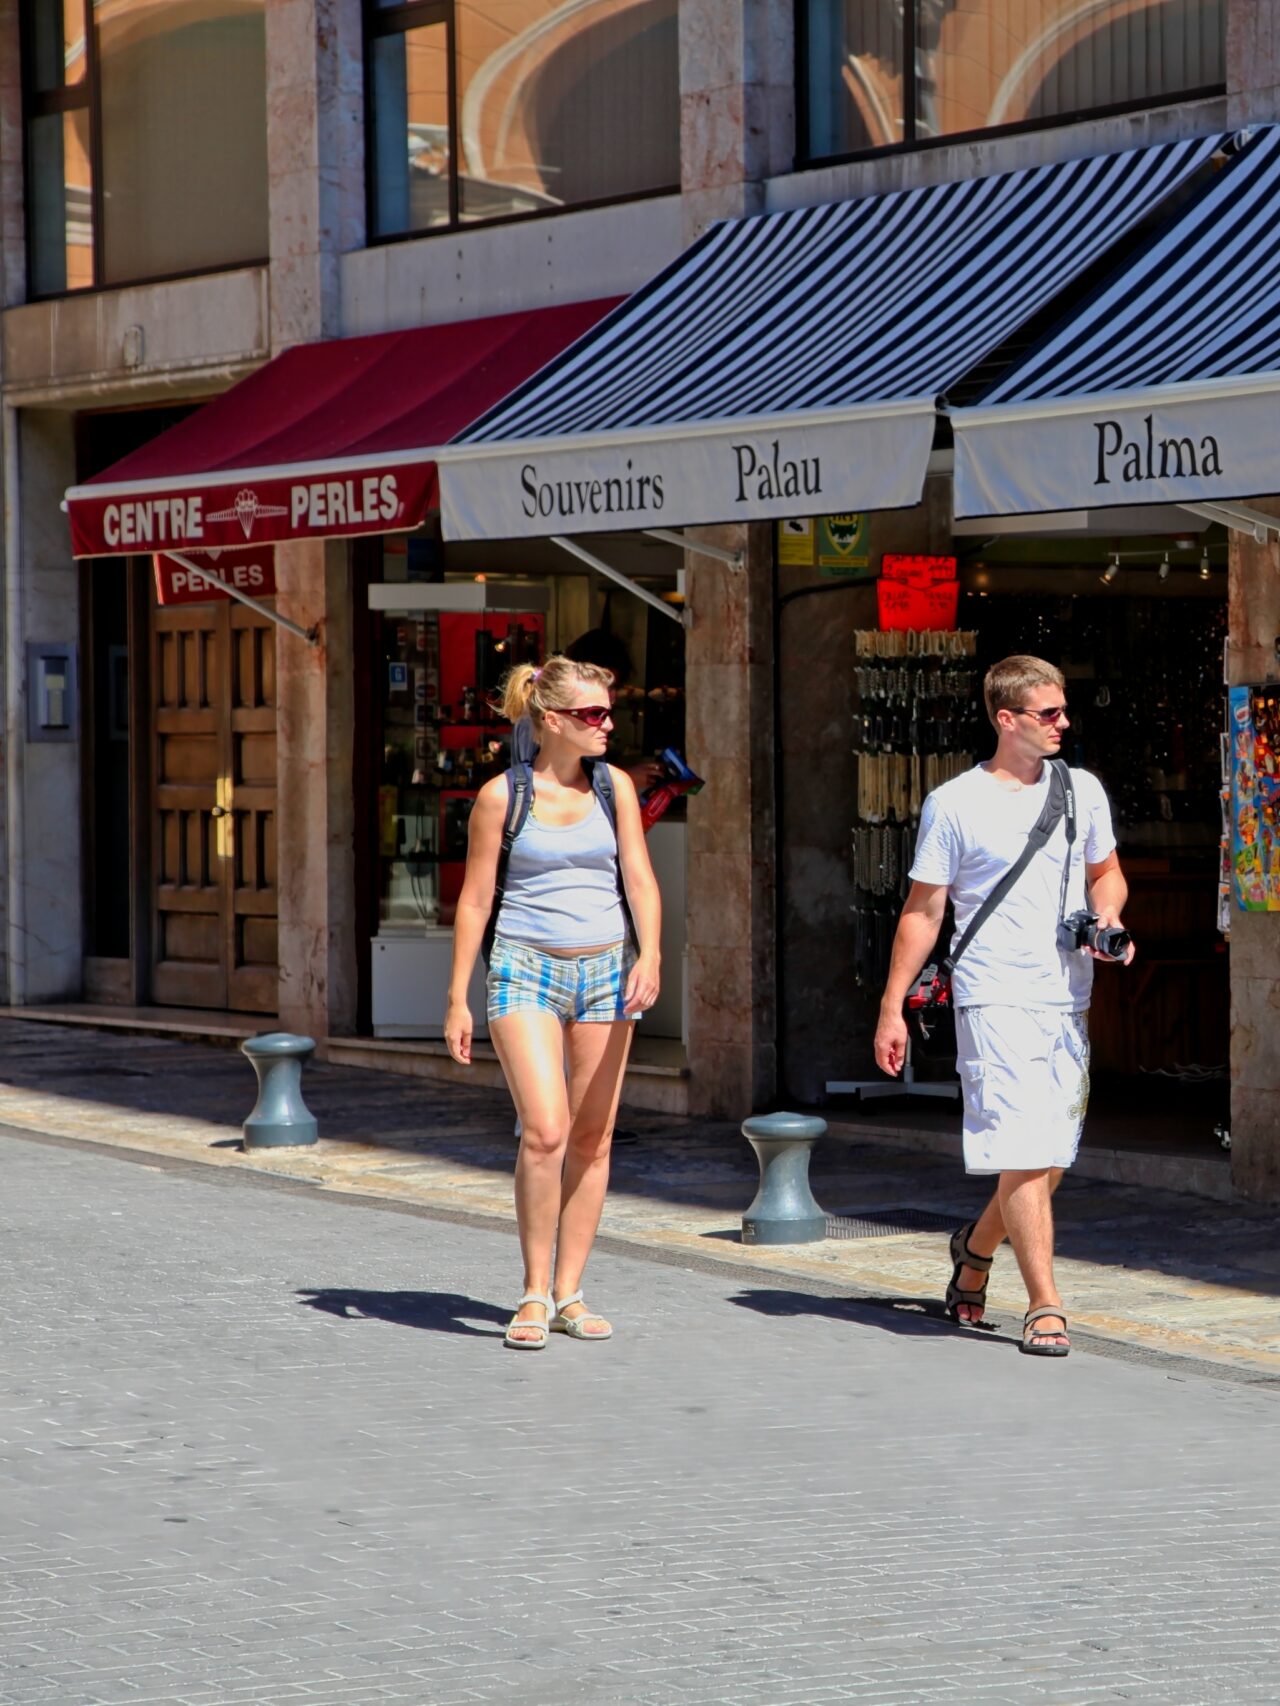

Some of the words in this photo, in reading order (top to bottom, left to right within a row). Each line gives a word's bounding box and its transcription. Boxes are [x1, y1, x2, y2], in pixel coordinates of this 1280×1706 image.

[520, 459, 665, 518] Souvenirs
[732, 440, 823, 503] Palau
[1093, 414, 1223, 485] Palma
[102, 496, 204, 546] CENTRE
[291, 474, 399, 529] PERLES
